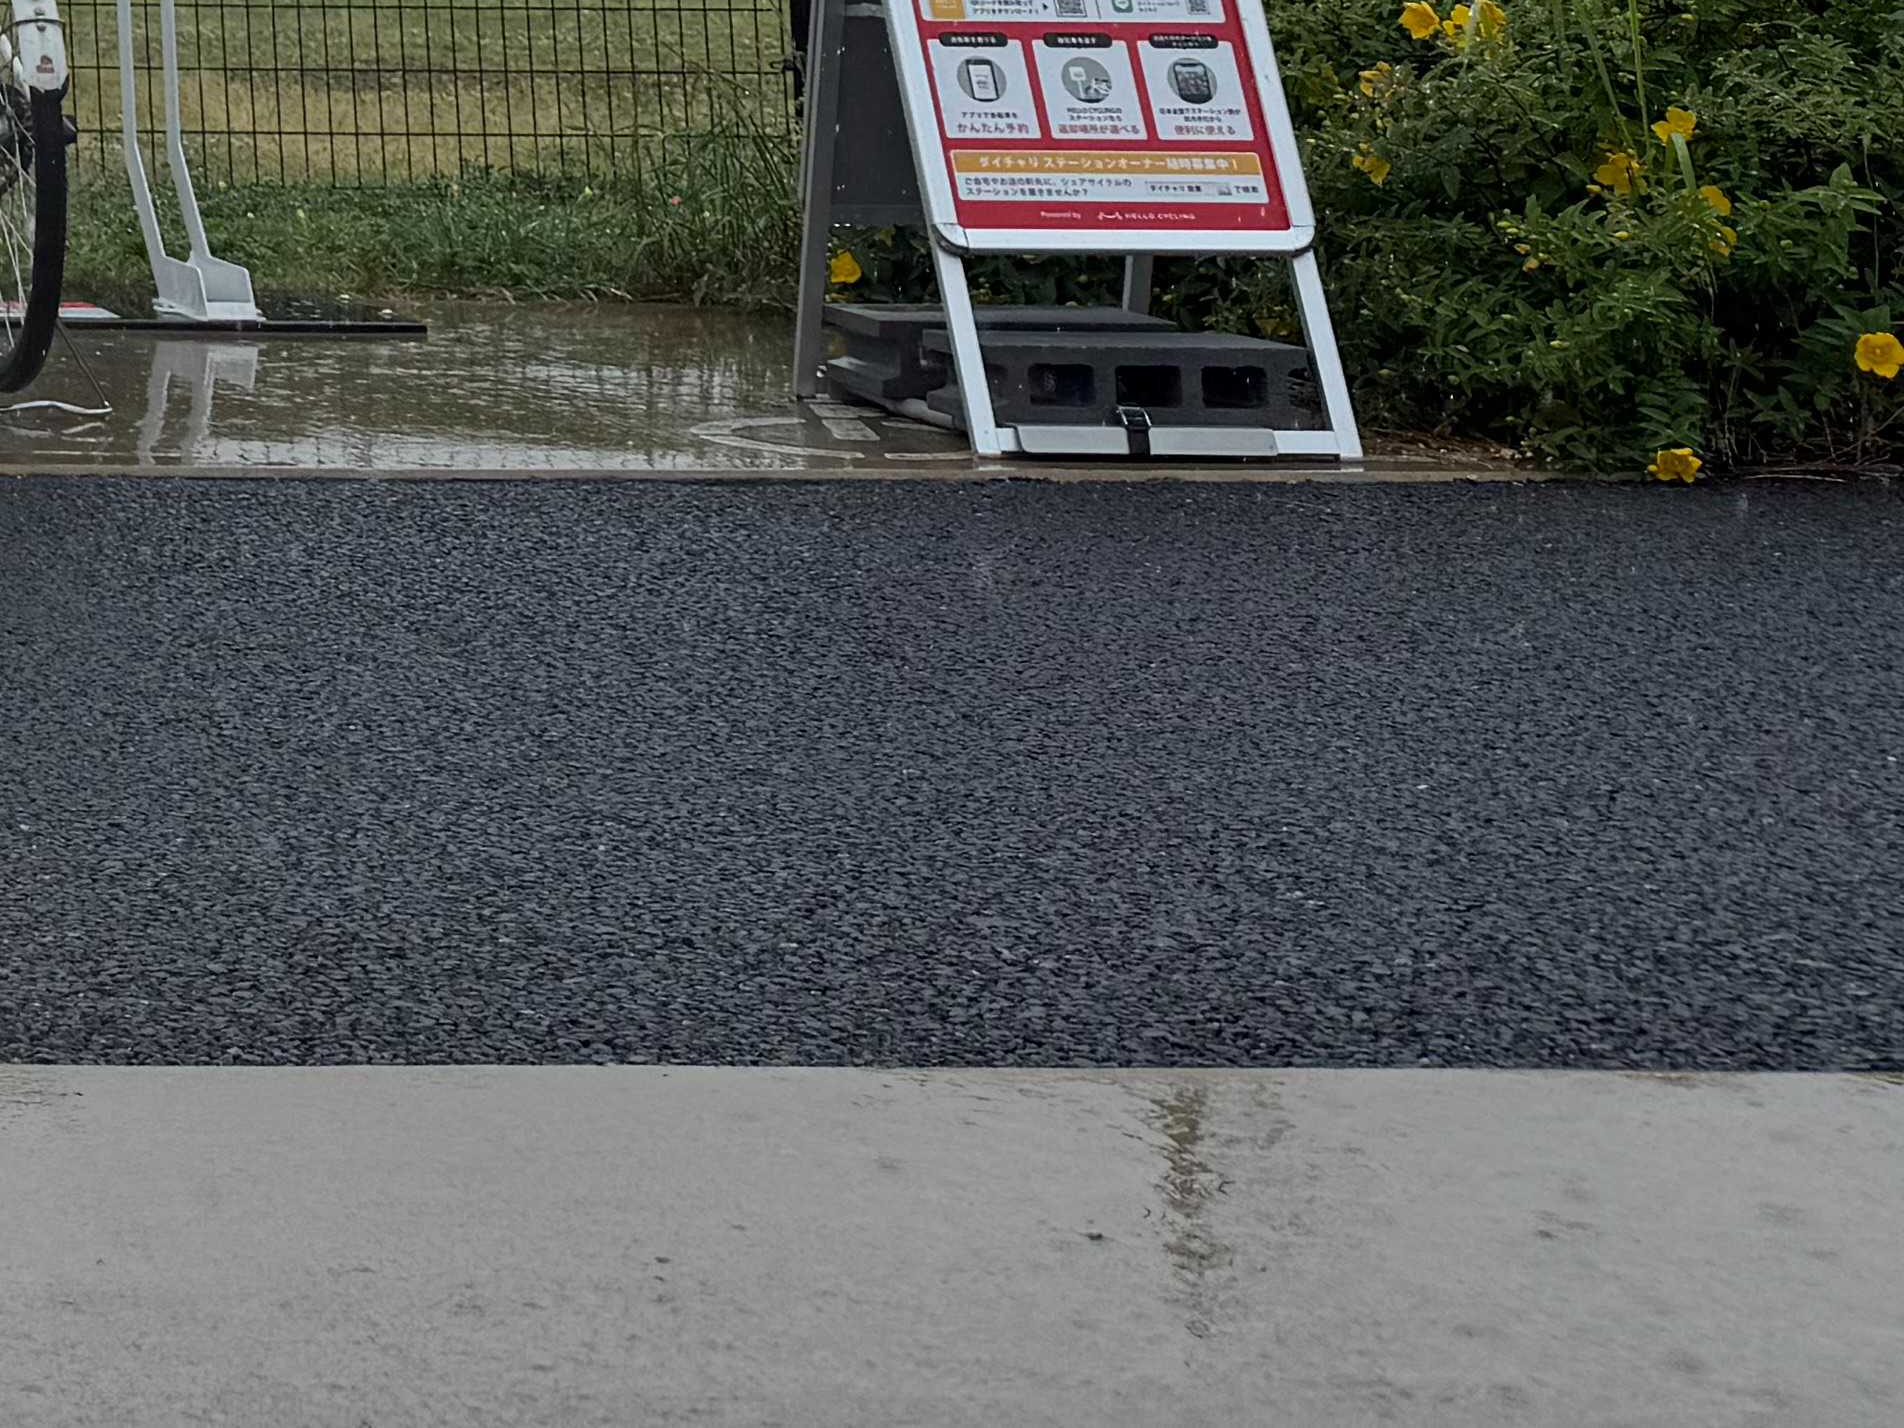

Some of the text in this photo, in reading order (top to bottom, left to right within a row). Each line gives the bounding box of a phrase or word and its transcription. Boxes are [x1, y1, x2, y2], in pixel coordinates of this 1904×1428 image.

[957, 123, 1029, 134] かんたん予約
[979, 156, 1039, 168] ダイチャリ
